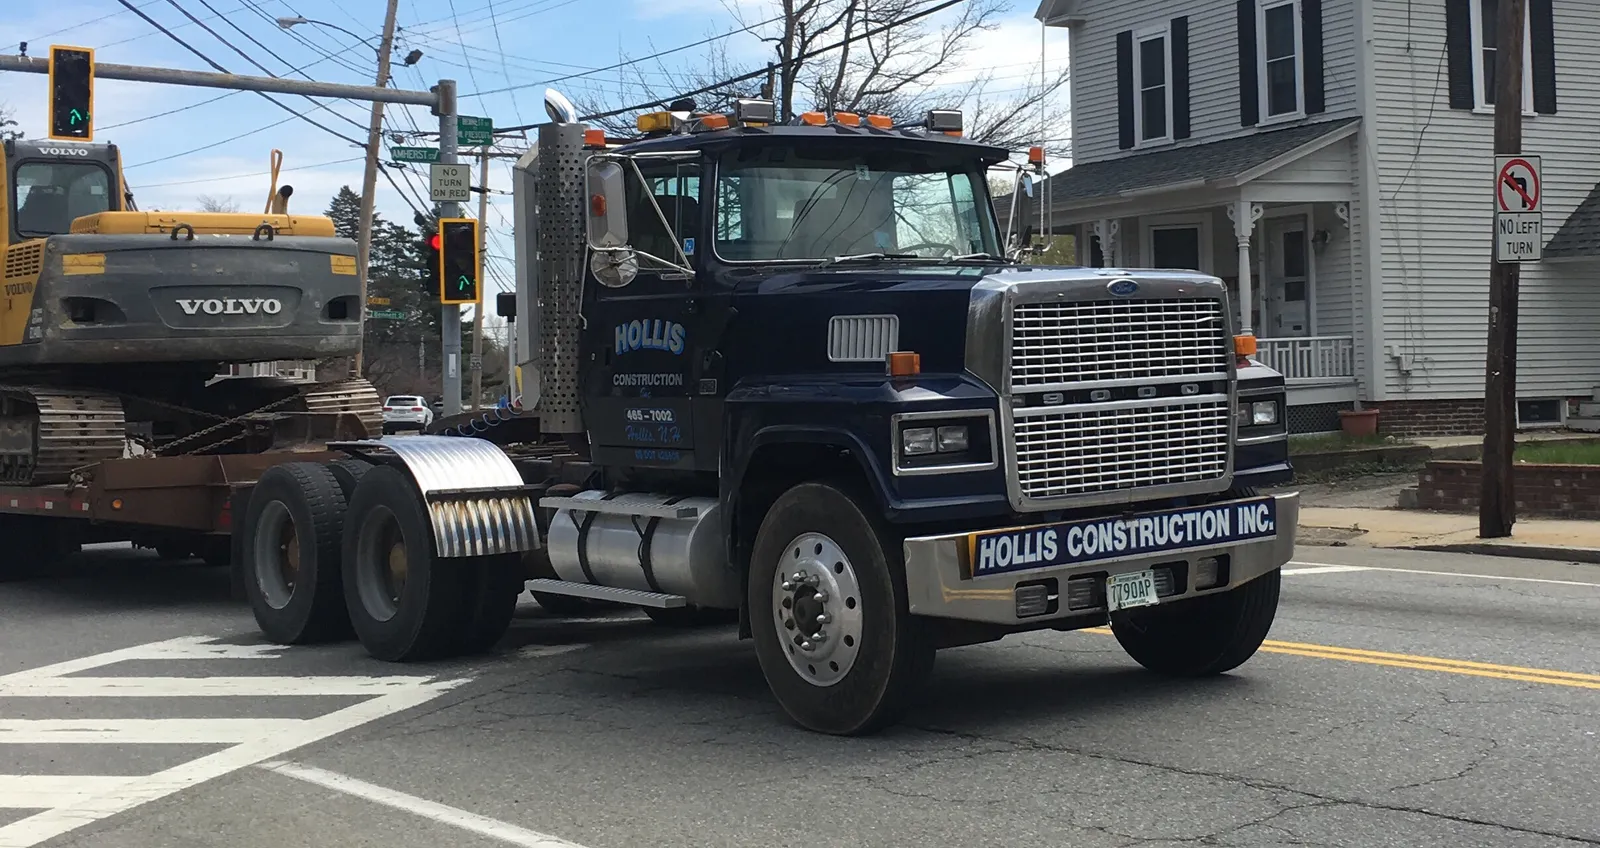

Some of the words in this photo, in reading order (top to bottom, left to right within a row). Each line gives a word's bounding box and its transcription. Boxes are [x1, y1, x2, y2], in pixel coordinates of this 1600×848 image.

[38, 147, 88, 156] VOLVO
[391, 149, 428, 160] AMHERST
[442, 168, 458, 177] NO
[439, 179, 462, 187] TURN
[433, 189, 446, 197] ON
[449, 189, 467, 198] RED
[1500, 219, 1513, 235] NO
[1516, 221, 1540, 234] LEFT
[1506, 242, 1533, 254] TURN
[4, 282, 33, 296] VOLVO
[175, 298, 282, 315] VOLVO
[615, 318, 686, 355] HOLLIS
[613, 373, 683, 386] CONSTRUCTION
[979, 530, 1058, 570] HOLLIS
[1067, 509, 1230, 558] CONSTRUCTION
[1237, 503, 1274, 535] INC.
[1111, 579, 1151, 603] 7790AP
